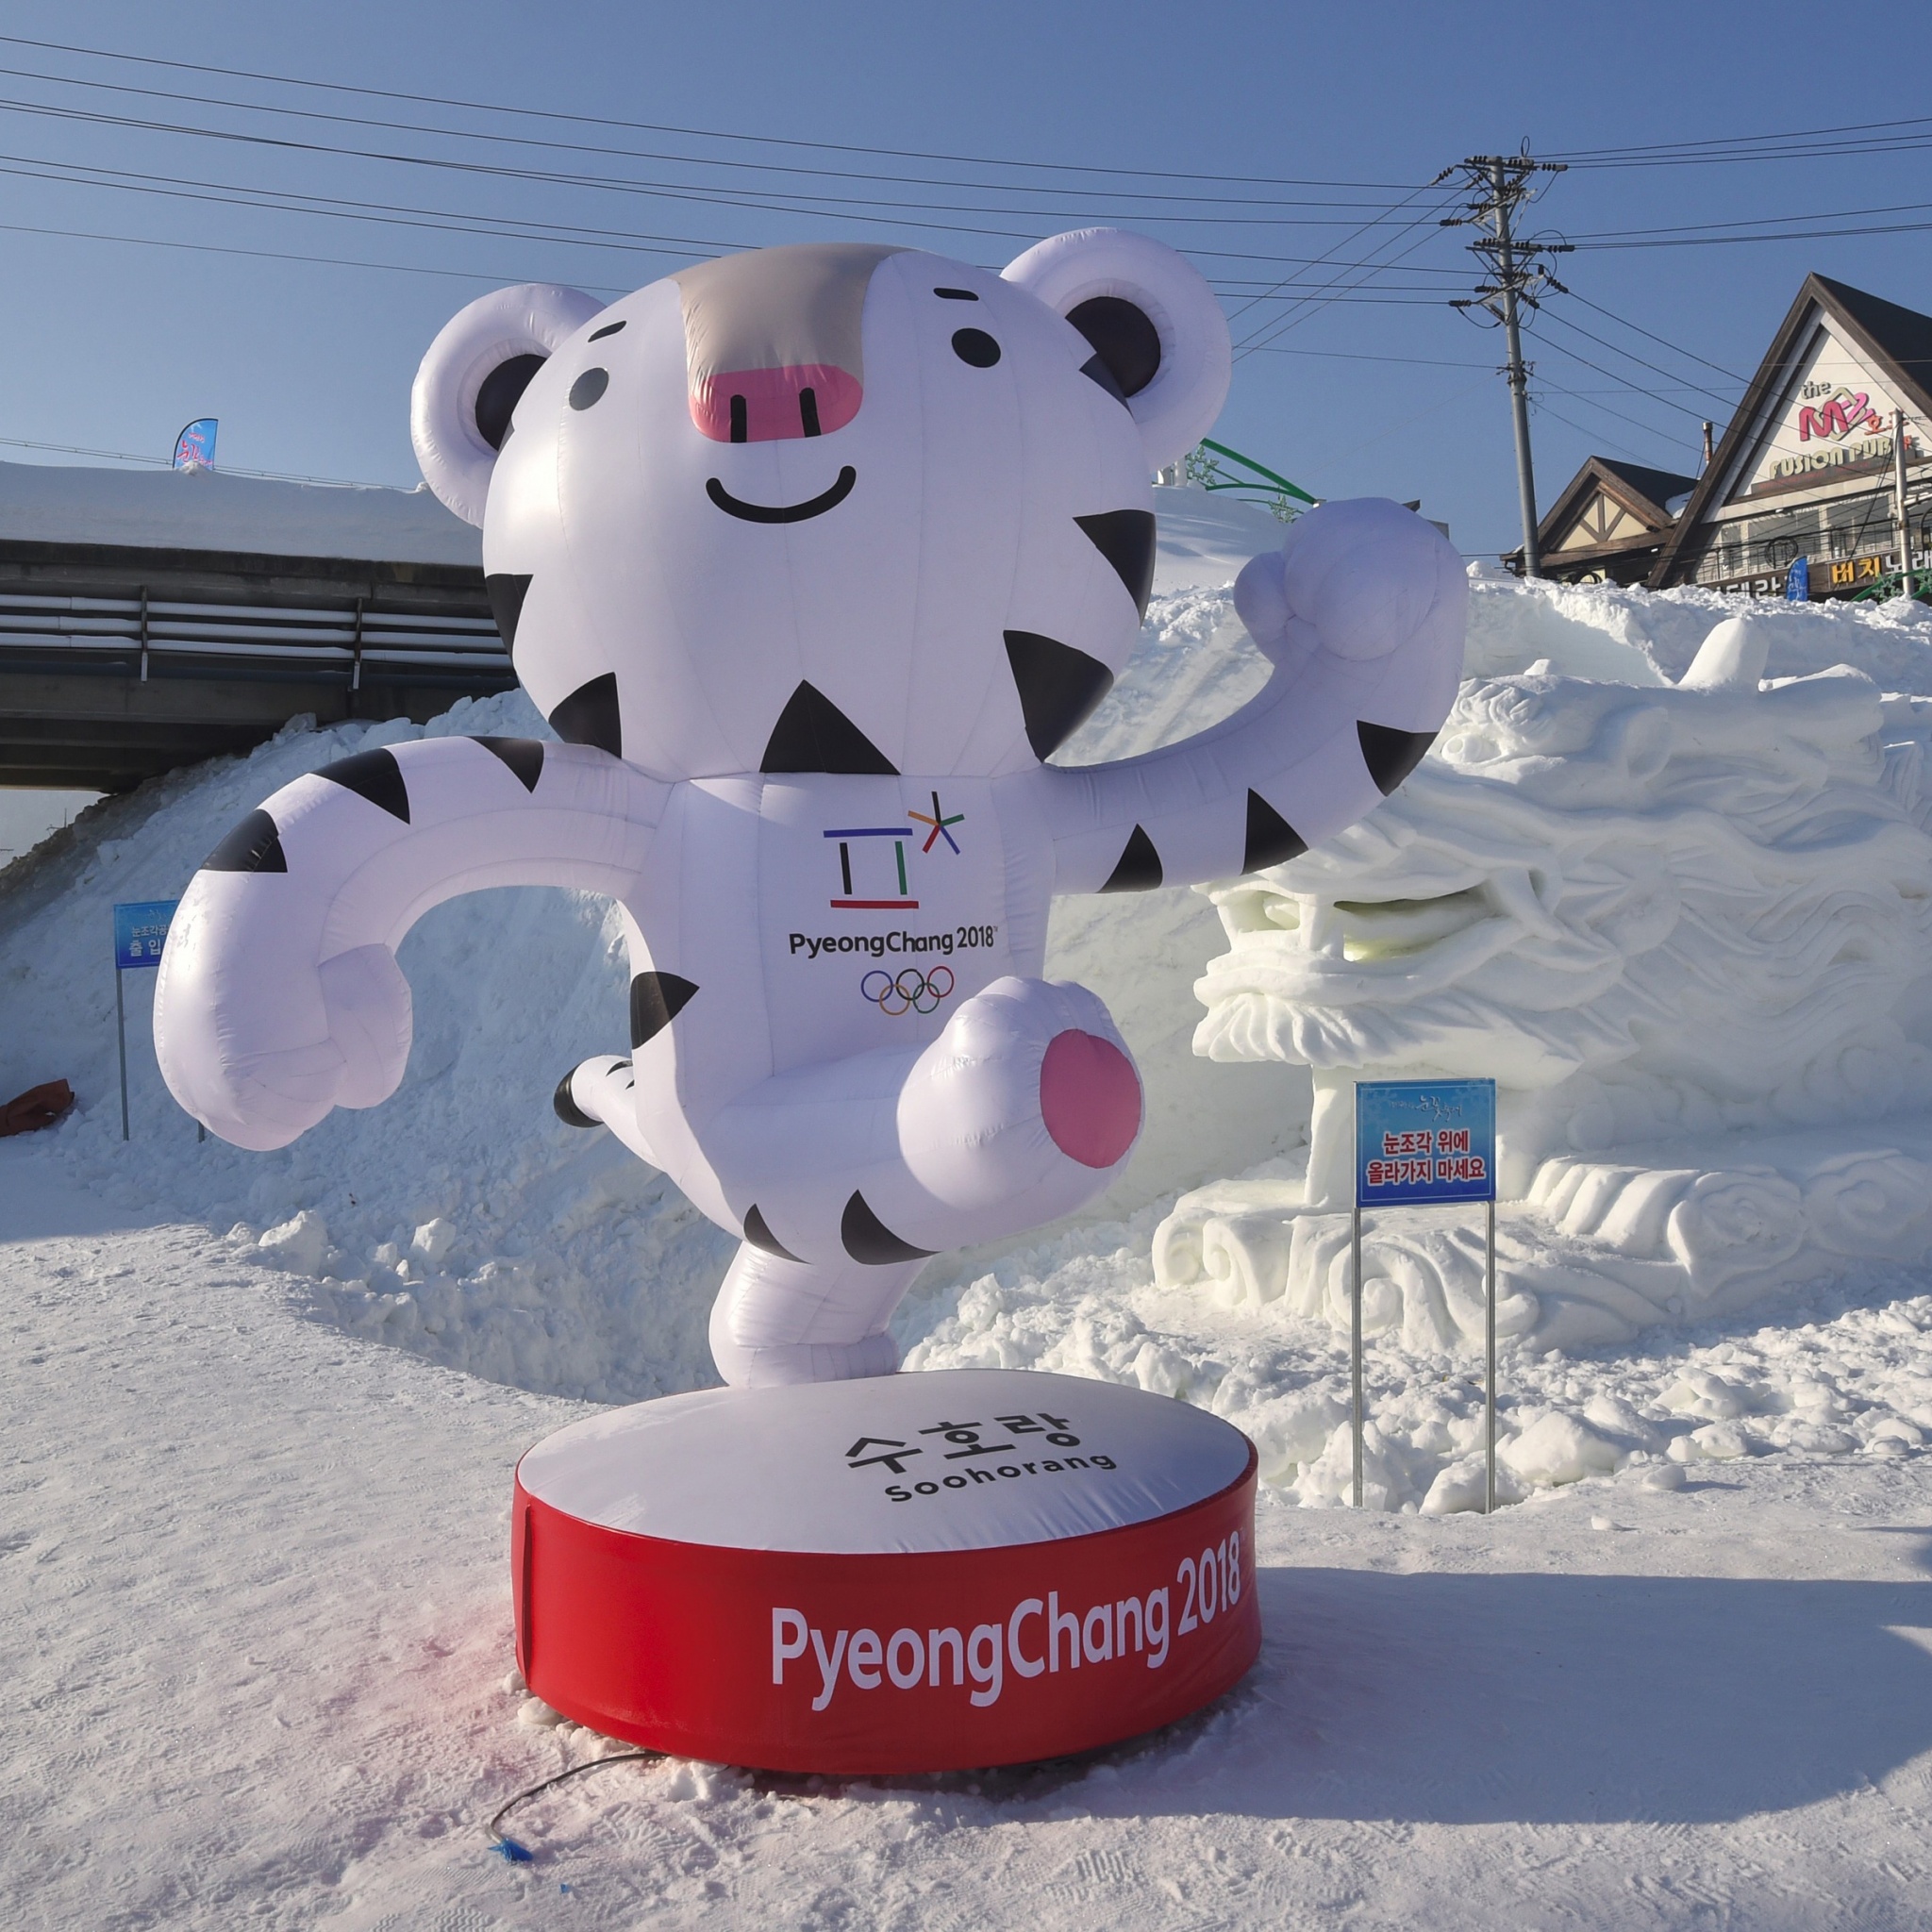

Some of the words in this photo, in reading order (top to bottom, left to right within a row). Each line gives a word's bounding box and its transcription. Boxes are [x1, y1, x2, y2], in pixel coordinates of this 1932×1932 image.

[1801, 381, 1831, 400] the
[1769, 446, 1843, 481] FUSION
[1849, 437, 1891, 463] PUB
[789, 931, 953, 958] PyeongChang
[957, 925, 994, 948] 2018
[1383, 1131, 1432, 1156] 눈조각
[1437, 1129, 1469, 1153] 위에
[1367, 1159, 1432, 1185] 올라가지
[1437, 1158, 1485, 1181] 마세요
[844, 1412, 1080, 1474] 수호랑
[884, 1455, 1117, 1502] Soohorang
[771, 1586, 1170, 1711] PyeongChang
[1176, 1530, 1241, 1637] 2018
